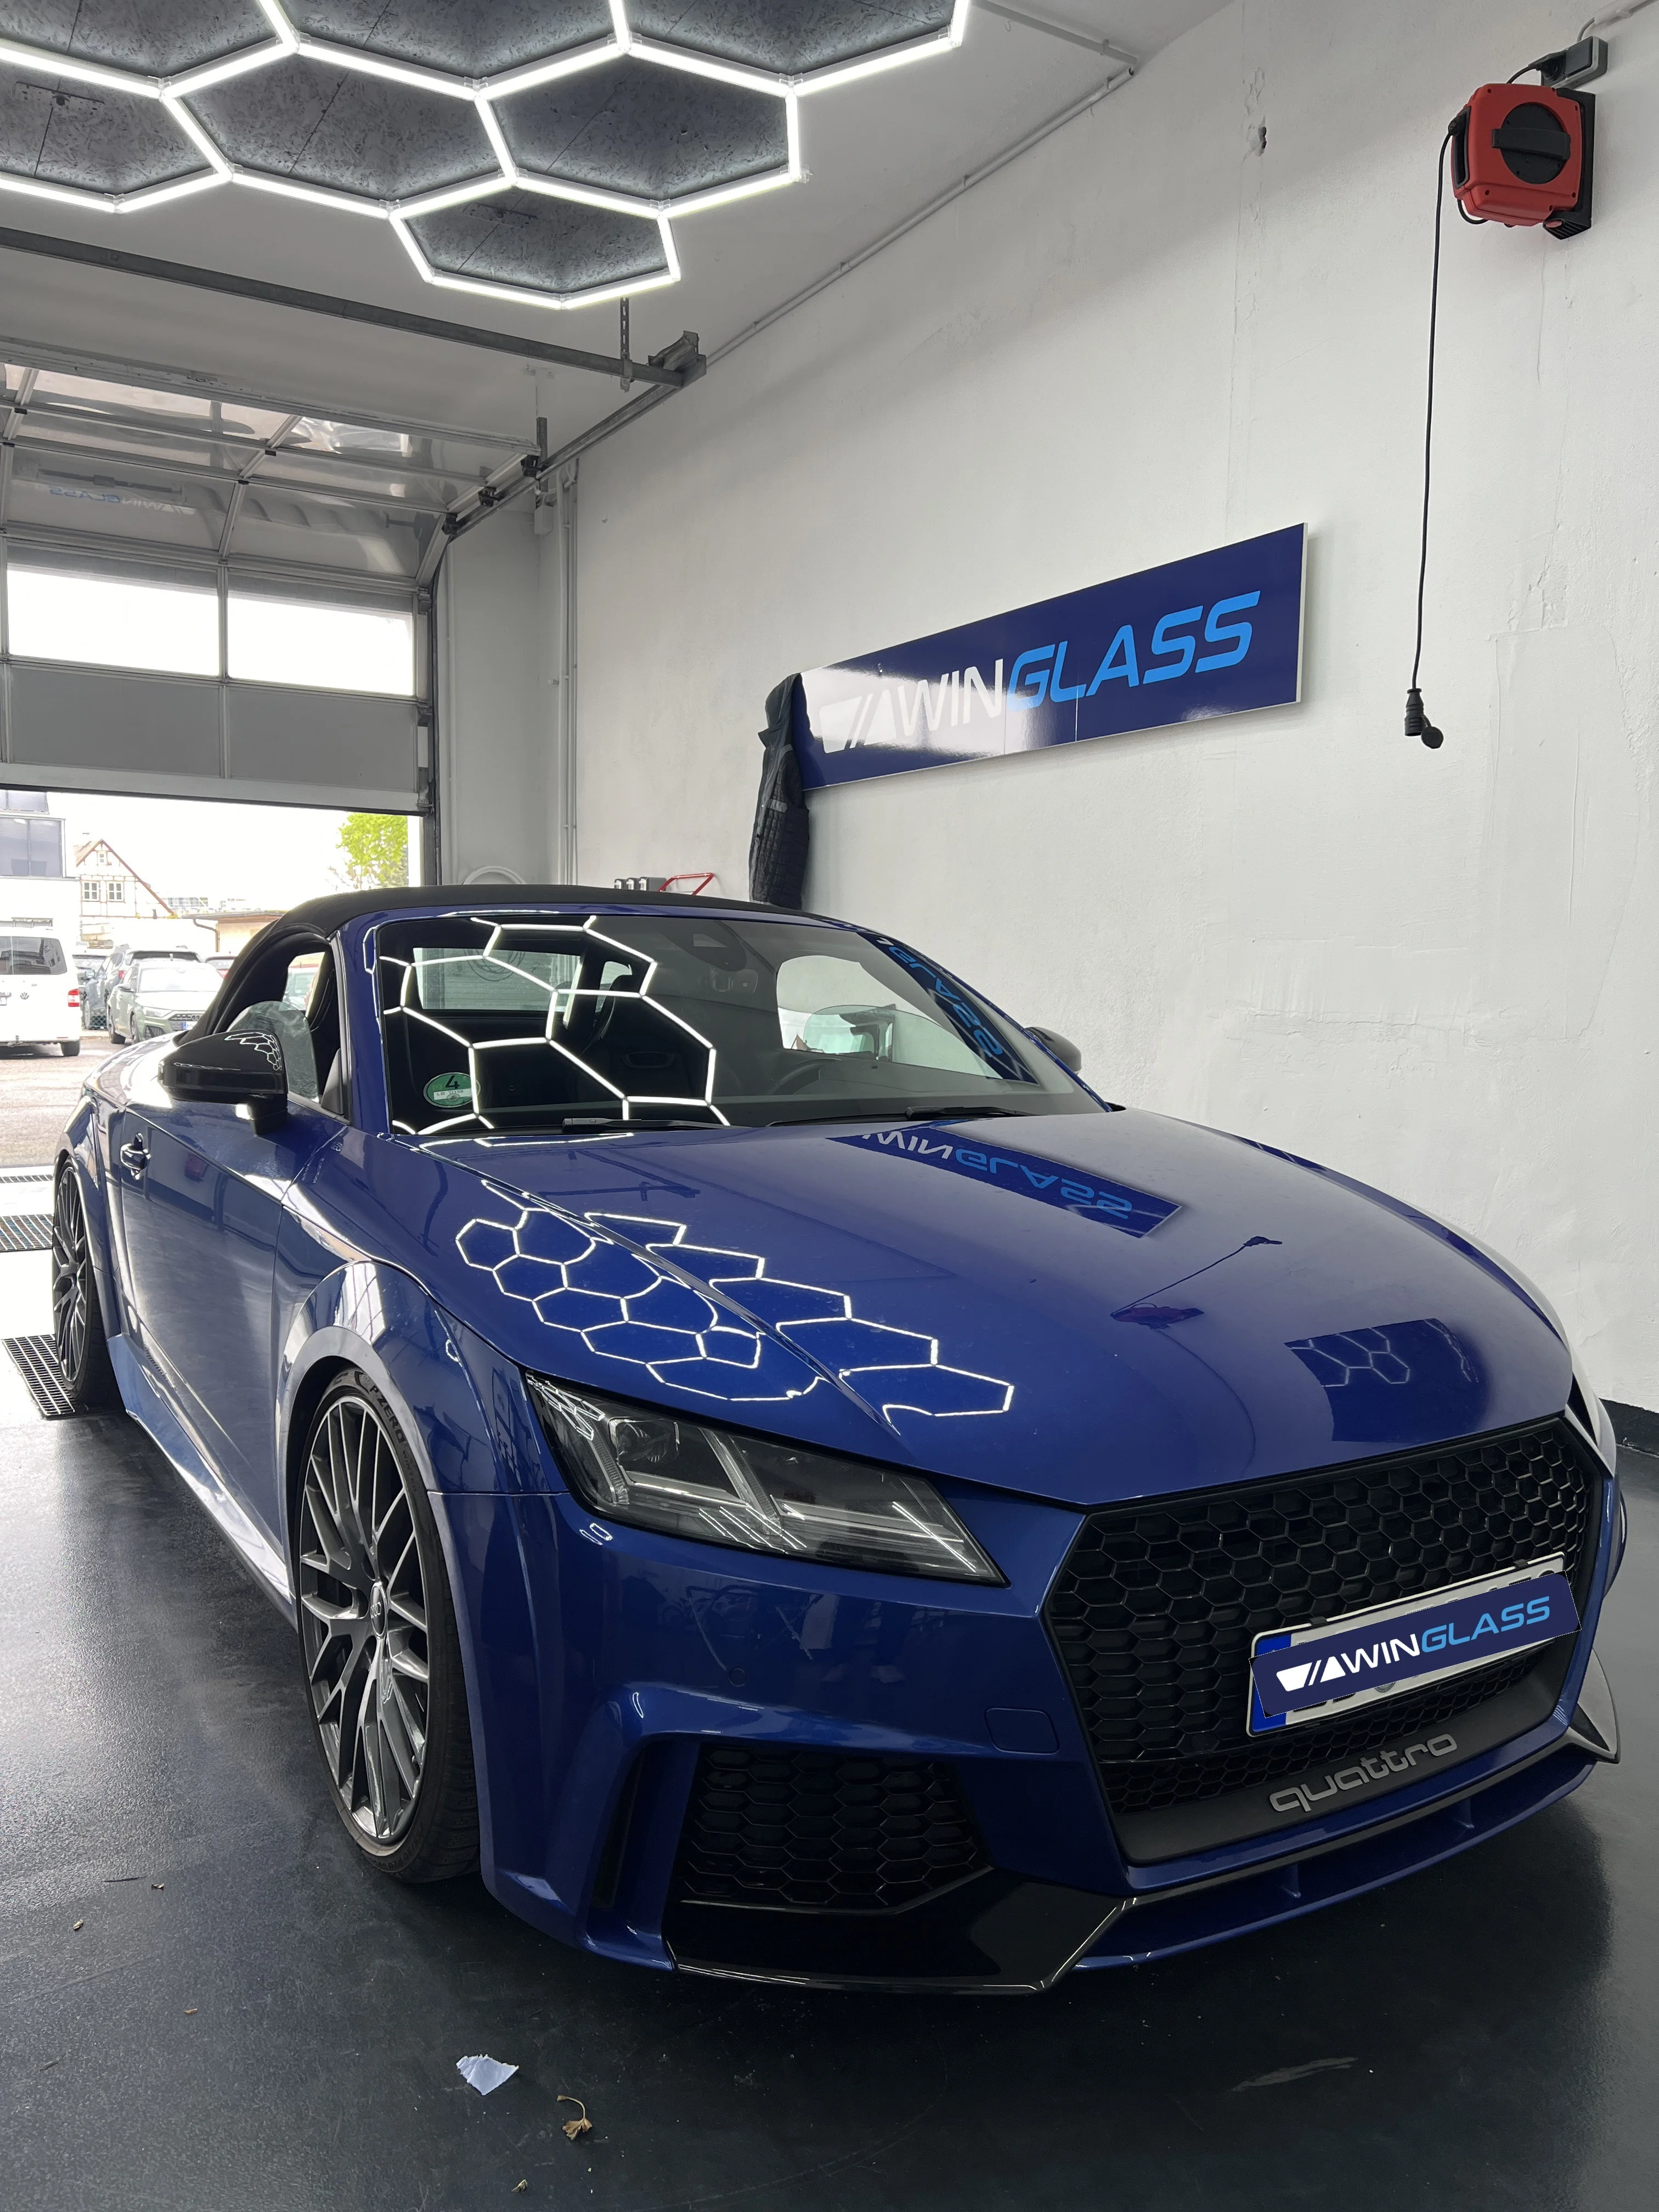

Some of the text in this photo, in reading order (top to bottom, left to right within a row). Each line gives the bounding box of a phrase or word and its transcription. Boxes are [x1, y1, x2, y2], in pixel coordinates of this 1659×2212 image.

[898, 590, 1261, 737] WINGLASS
[445, 1075, 460, 1090] 4
[369, 1385, 406, 1443] P ZERO
[1269, 1733, 1458, 1813] quattro
